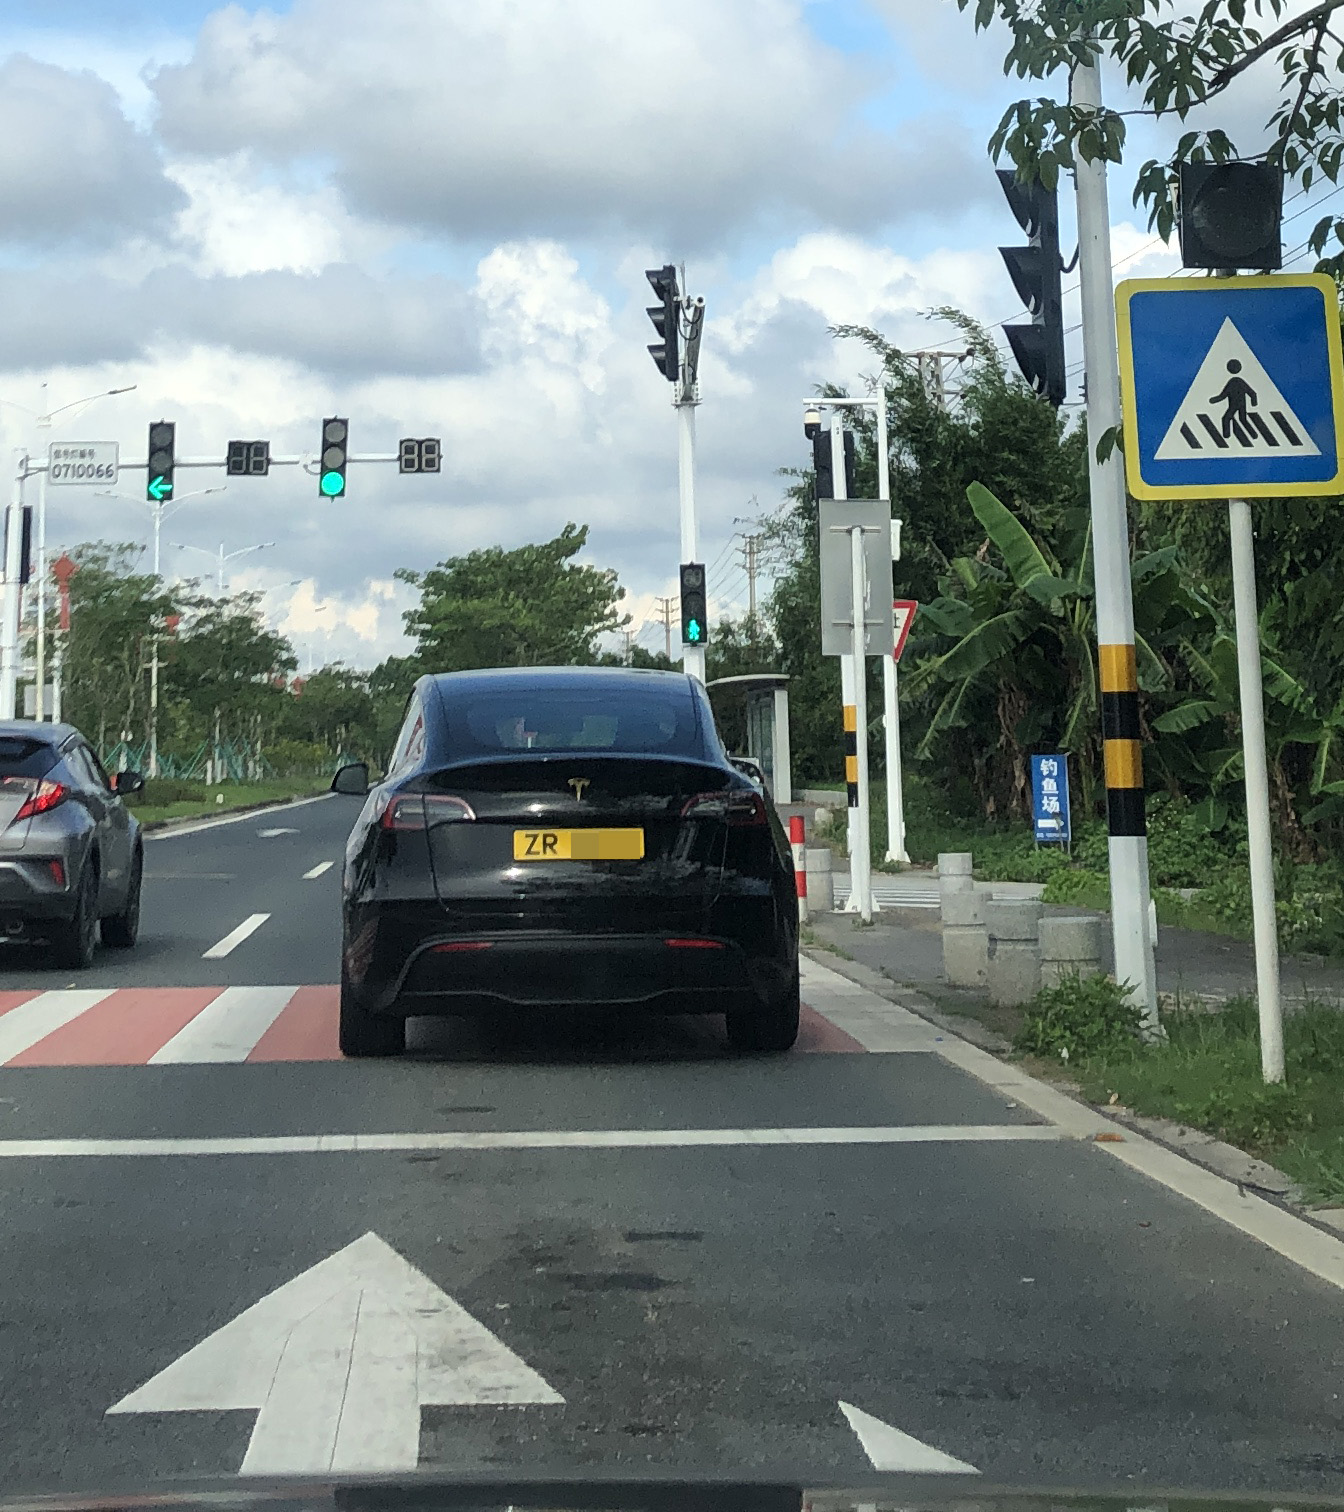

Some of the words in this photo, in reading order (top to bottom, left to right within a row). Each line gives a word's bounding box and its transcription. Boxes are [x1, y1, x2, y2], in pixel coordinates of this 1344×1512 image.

[52, 463, 114, 478] 0710066
[1040, 758, 1060, 814] 钓鱼场
[524, 833, 558, 855] ZR
